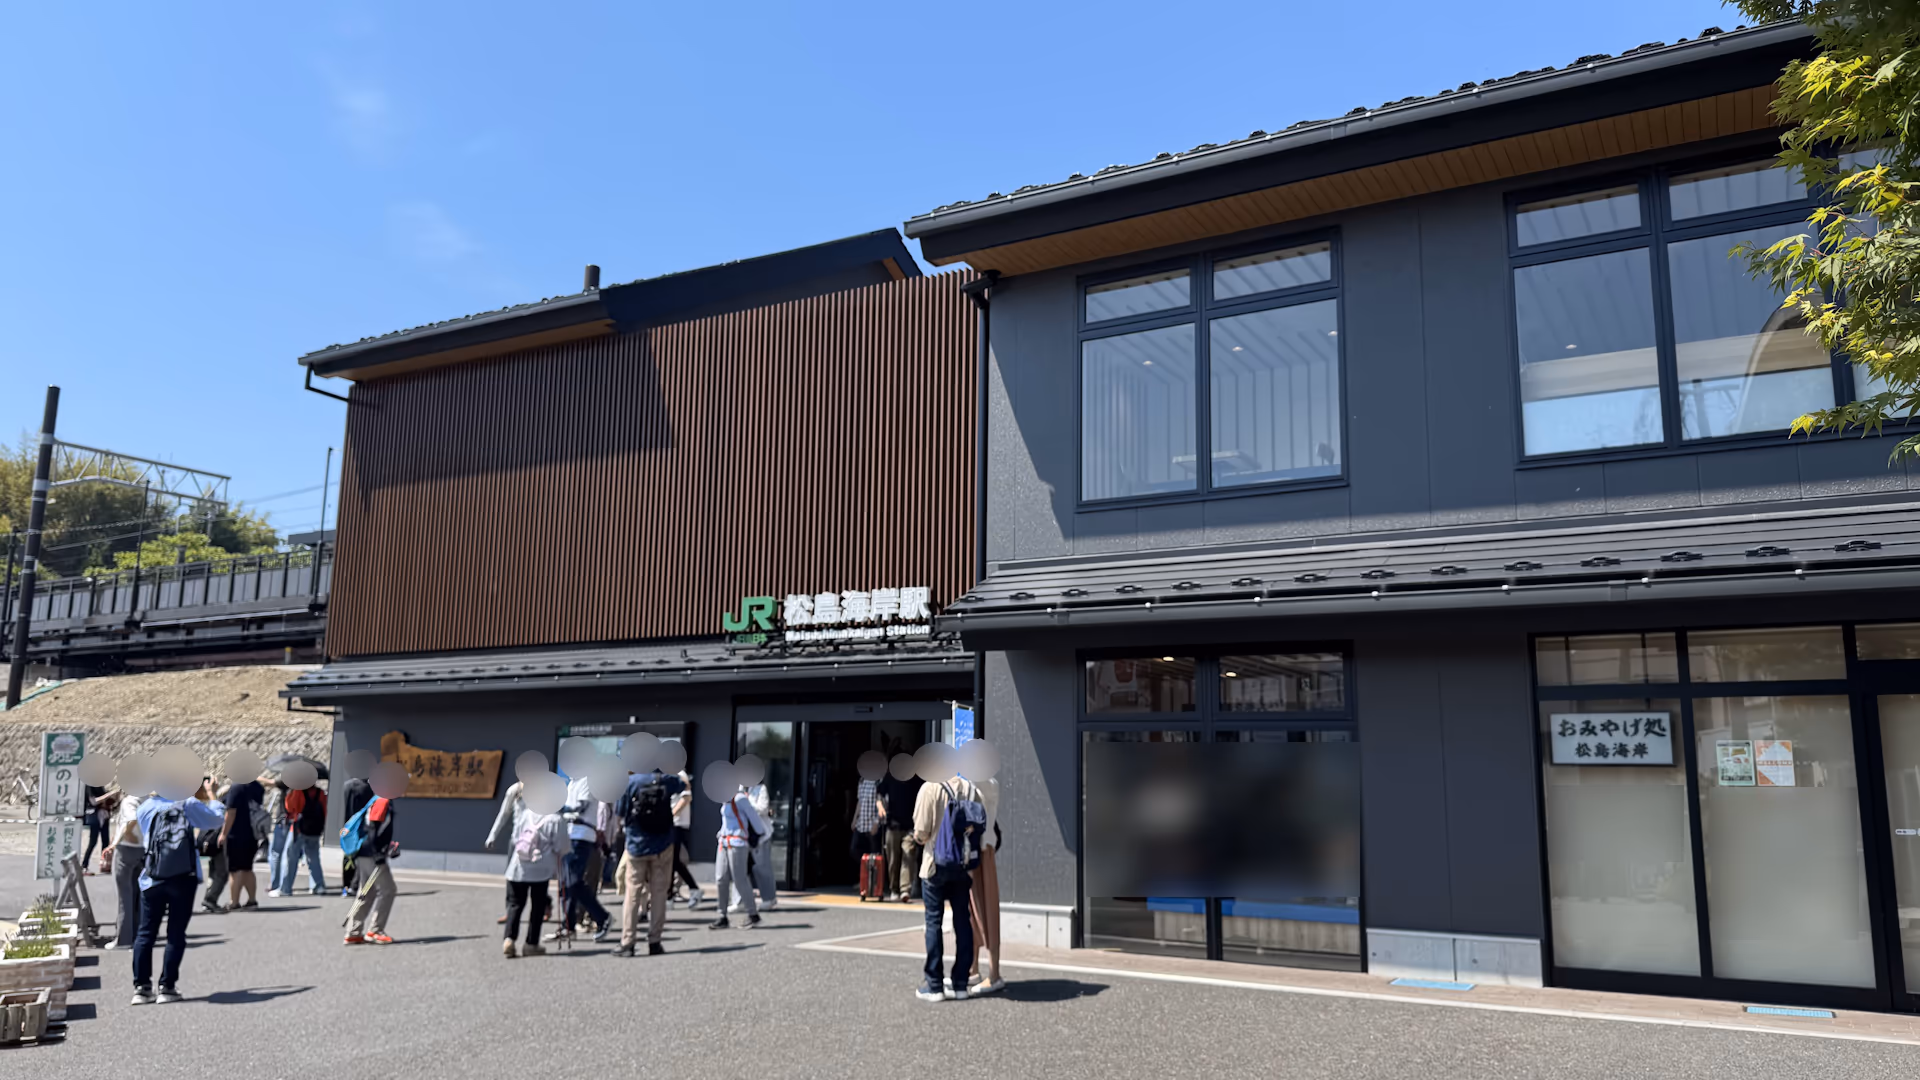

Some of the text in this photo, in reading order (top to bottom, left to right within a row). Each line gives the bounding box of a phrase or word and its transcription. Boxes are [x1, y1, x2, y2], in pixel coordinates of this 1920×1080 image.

[723, 596, 777, 631] JR
[783, 587, 931, 626] 松島海岸駅
[785, 624, 931, 641] Matsushimakaigan Station
[1557, 717, 1667, 738] おみやげ処
[48, 753, 82, 763] タクシー
[1575, 742, 1648, 759] 松島海岸
[396, 753, 485, 777] 島海岸駅
[55, 768, 72, 814] のりば
